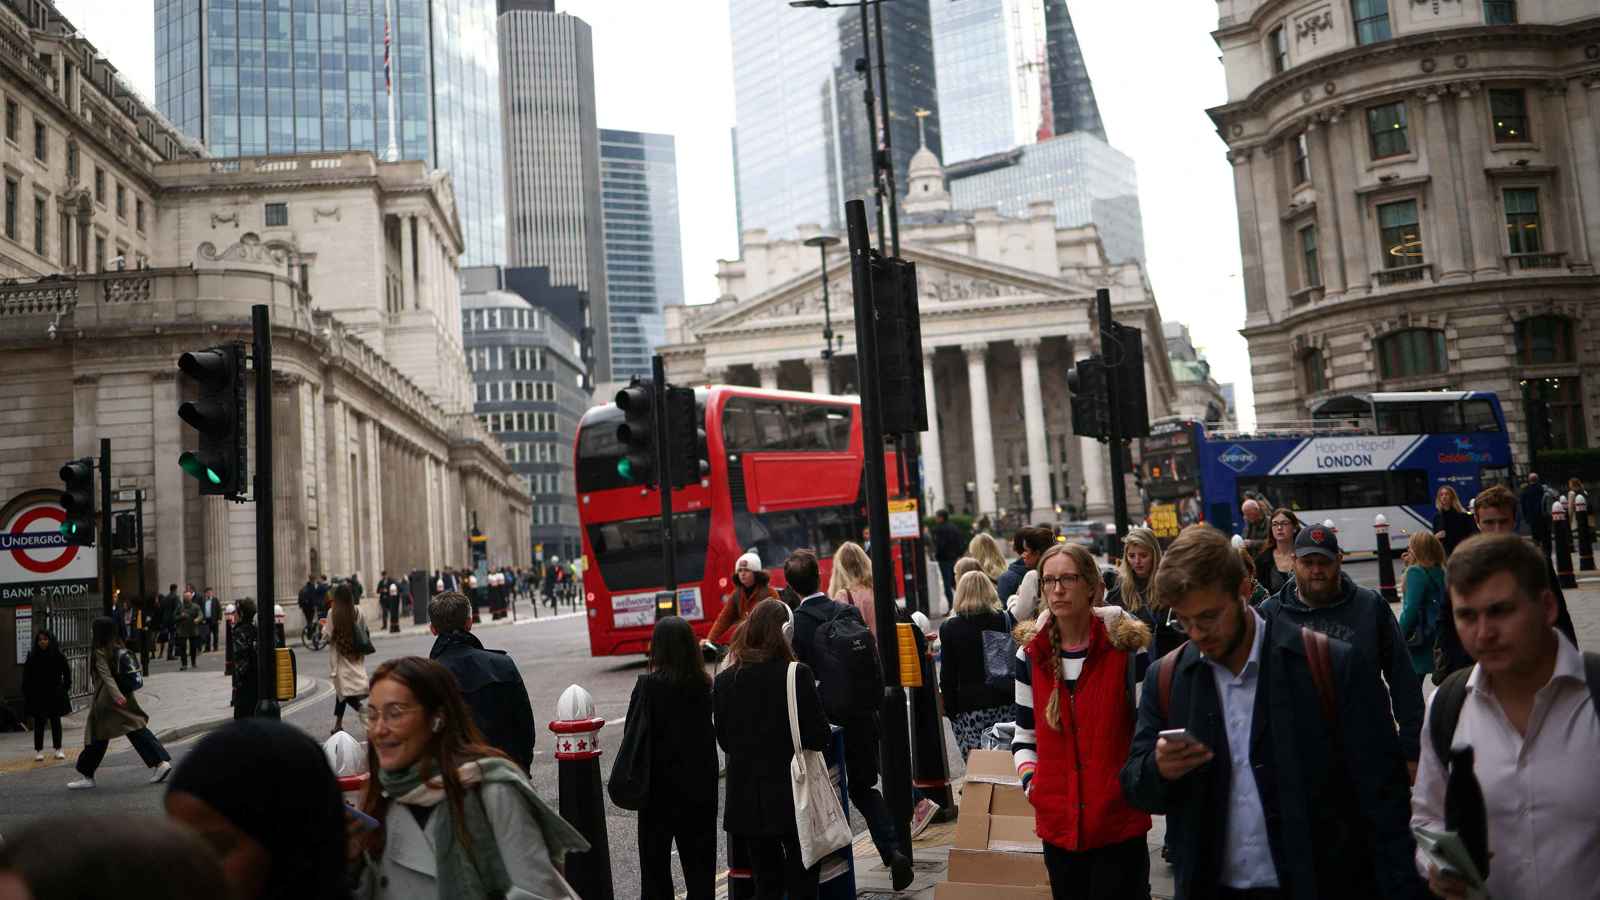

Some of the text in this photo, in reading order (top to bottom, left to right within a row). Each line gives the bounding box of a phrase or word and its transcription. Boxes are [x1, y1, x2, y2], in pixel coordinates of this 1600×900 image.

[1316, 454, 1372, 469] LONDON
[1, 535, 67, 548] UNDERGROU
[2, 583, 89, 599] BANK STATION
